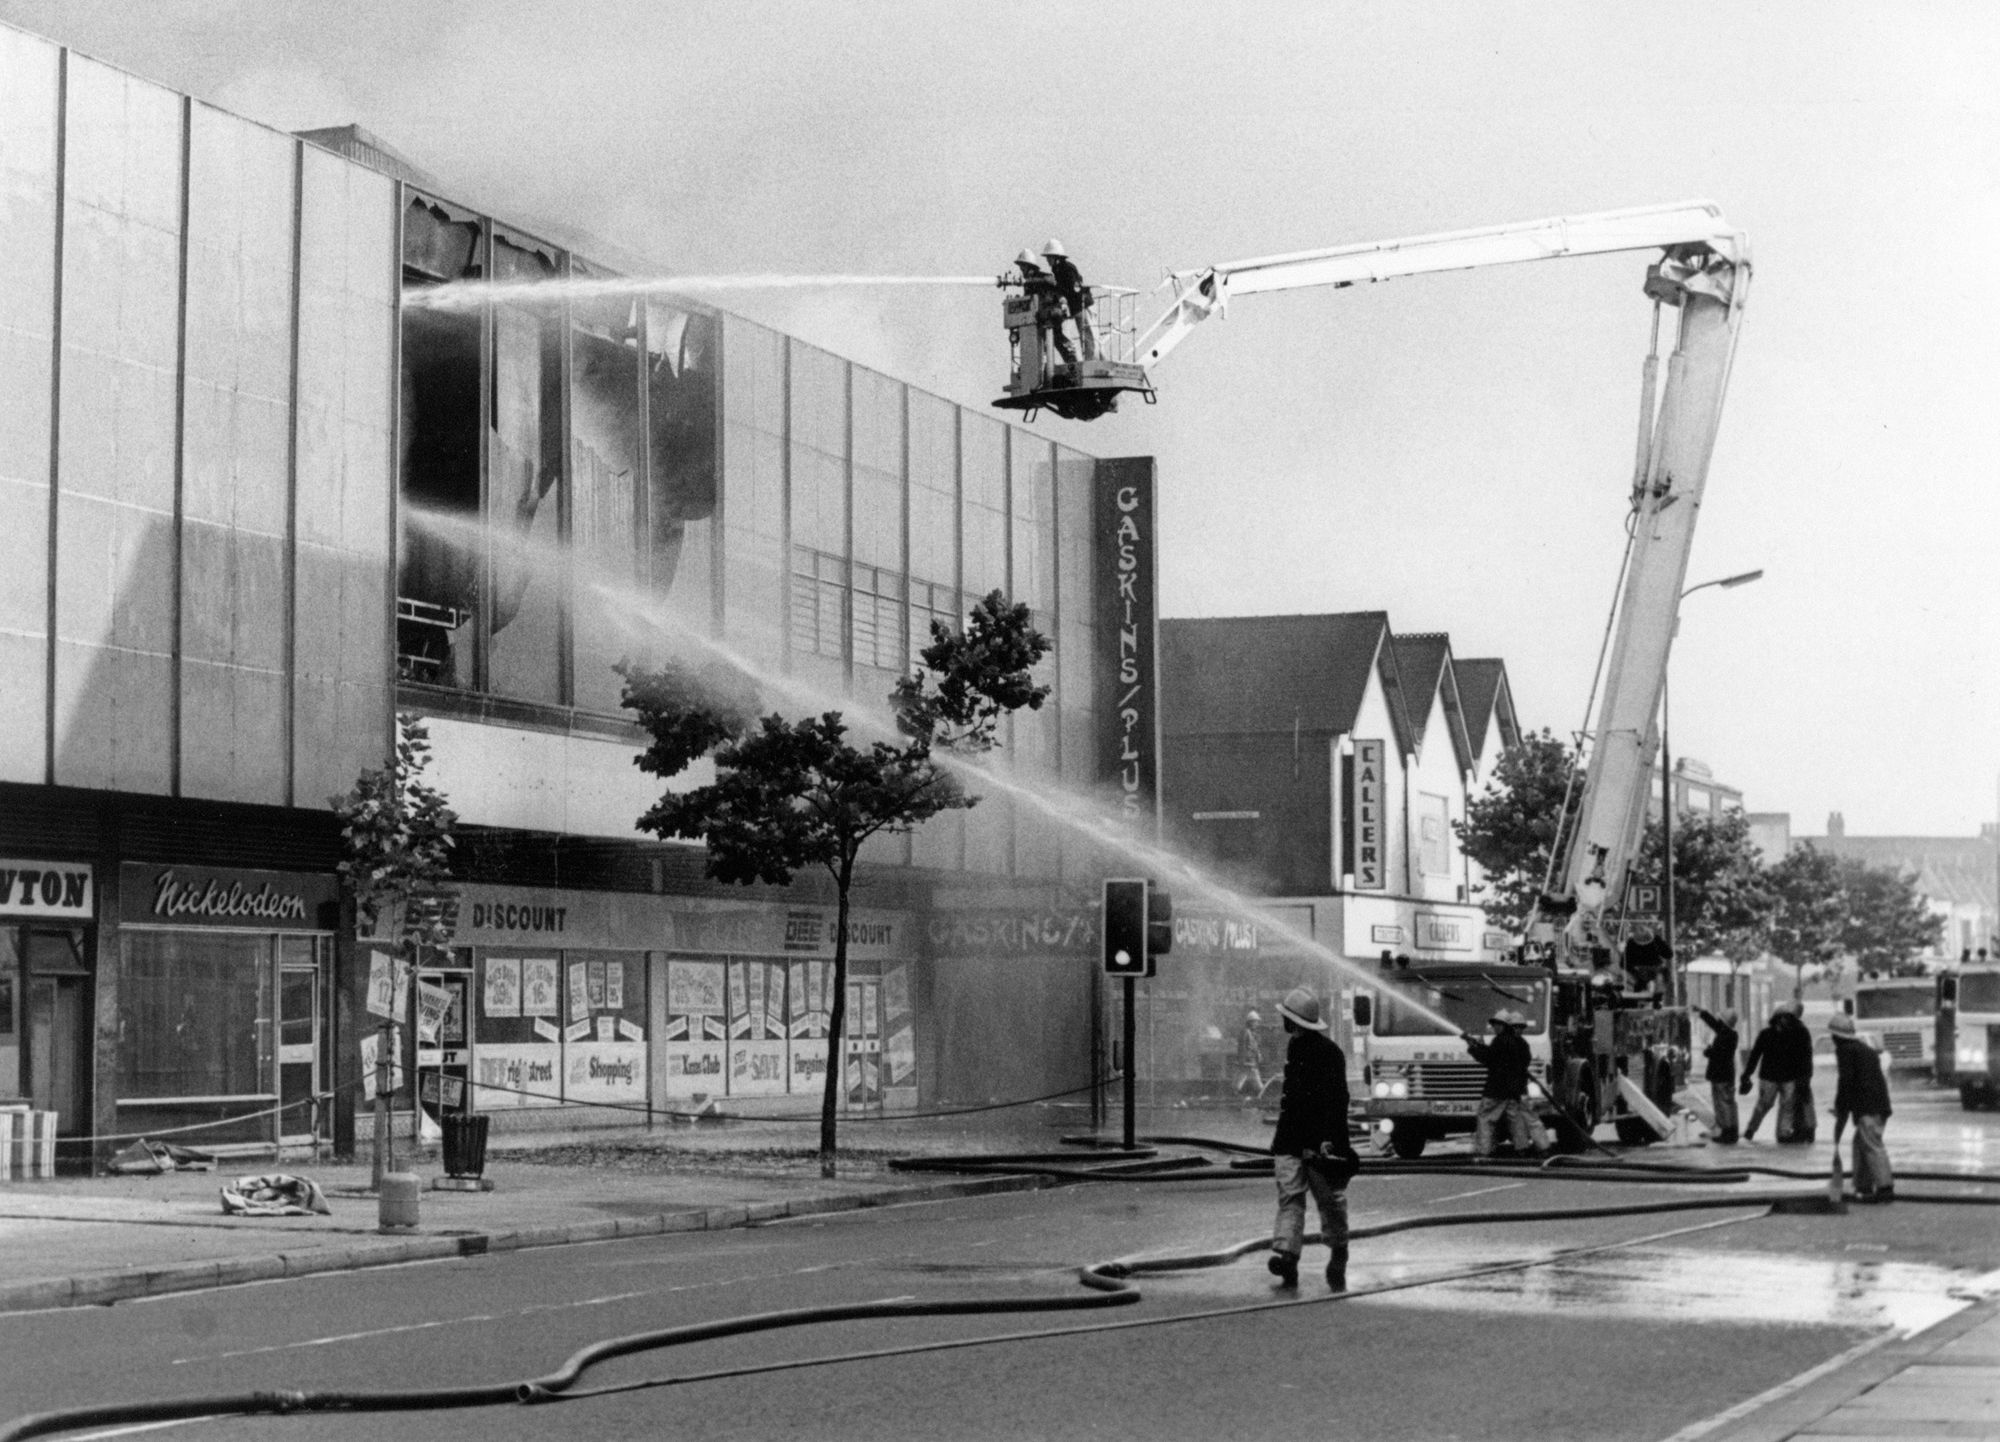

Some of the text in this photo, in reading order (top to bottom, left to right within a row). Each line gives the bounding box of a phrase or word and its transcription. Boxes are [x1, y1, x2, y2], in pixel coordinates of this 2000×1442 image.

[1360, 745, 1377, 884] CALLERS
[154, 869, 306, 919] Nickelodeon
[1639, 888, 1654, 910] P
[473, 903, 566, 932] DISCOUNT
[589, 1056, 633, 1086] Shopping
